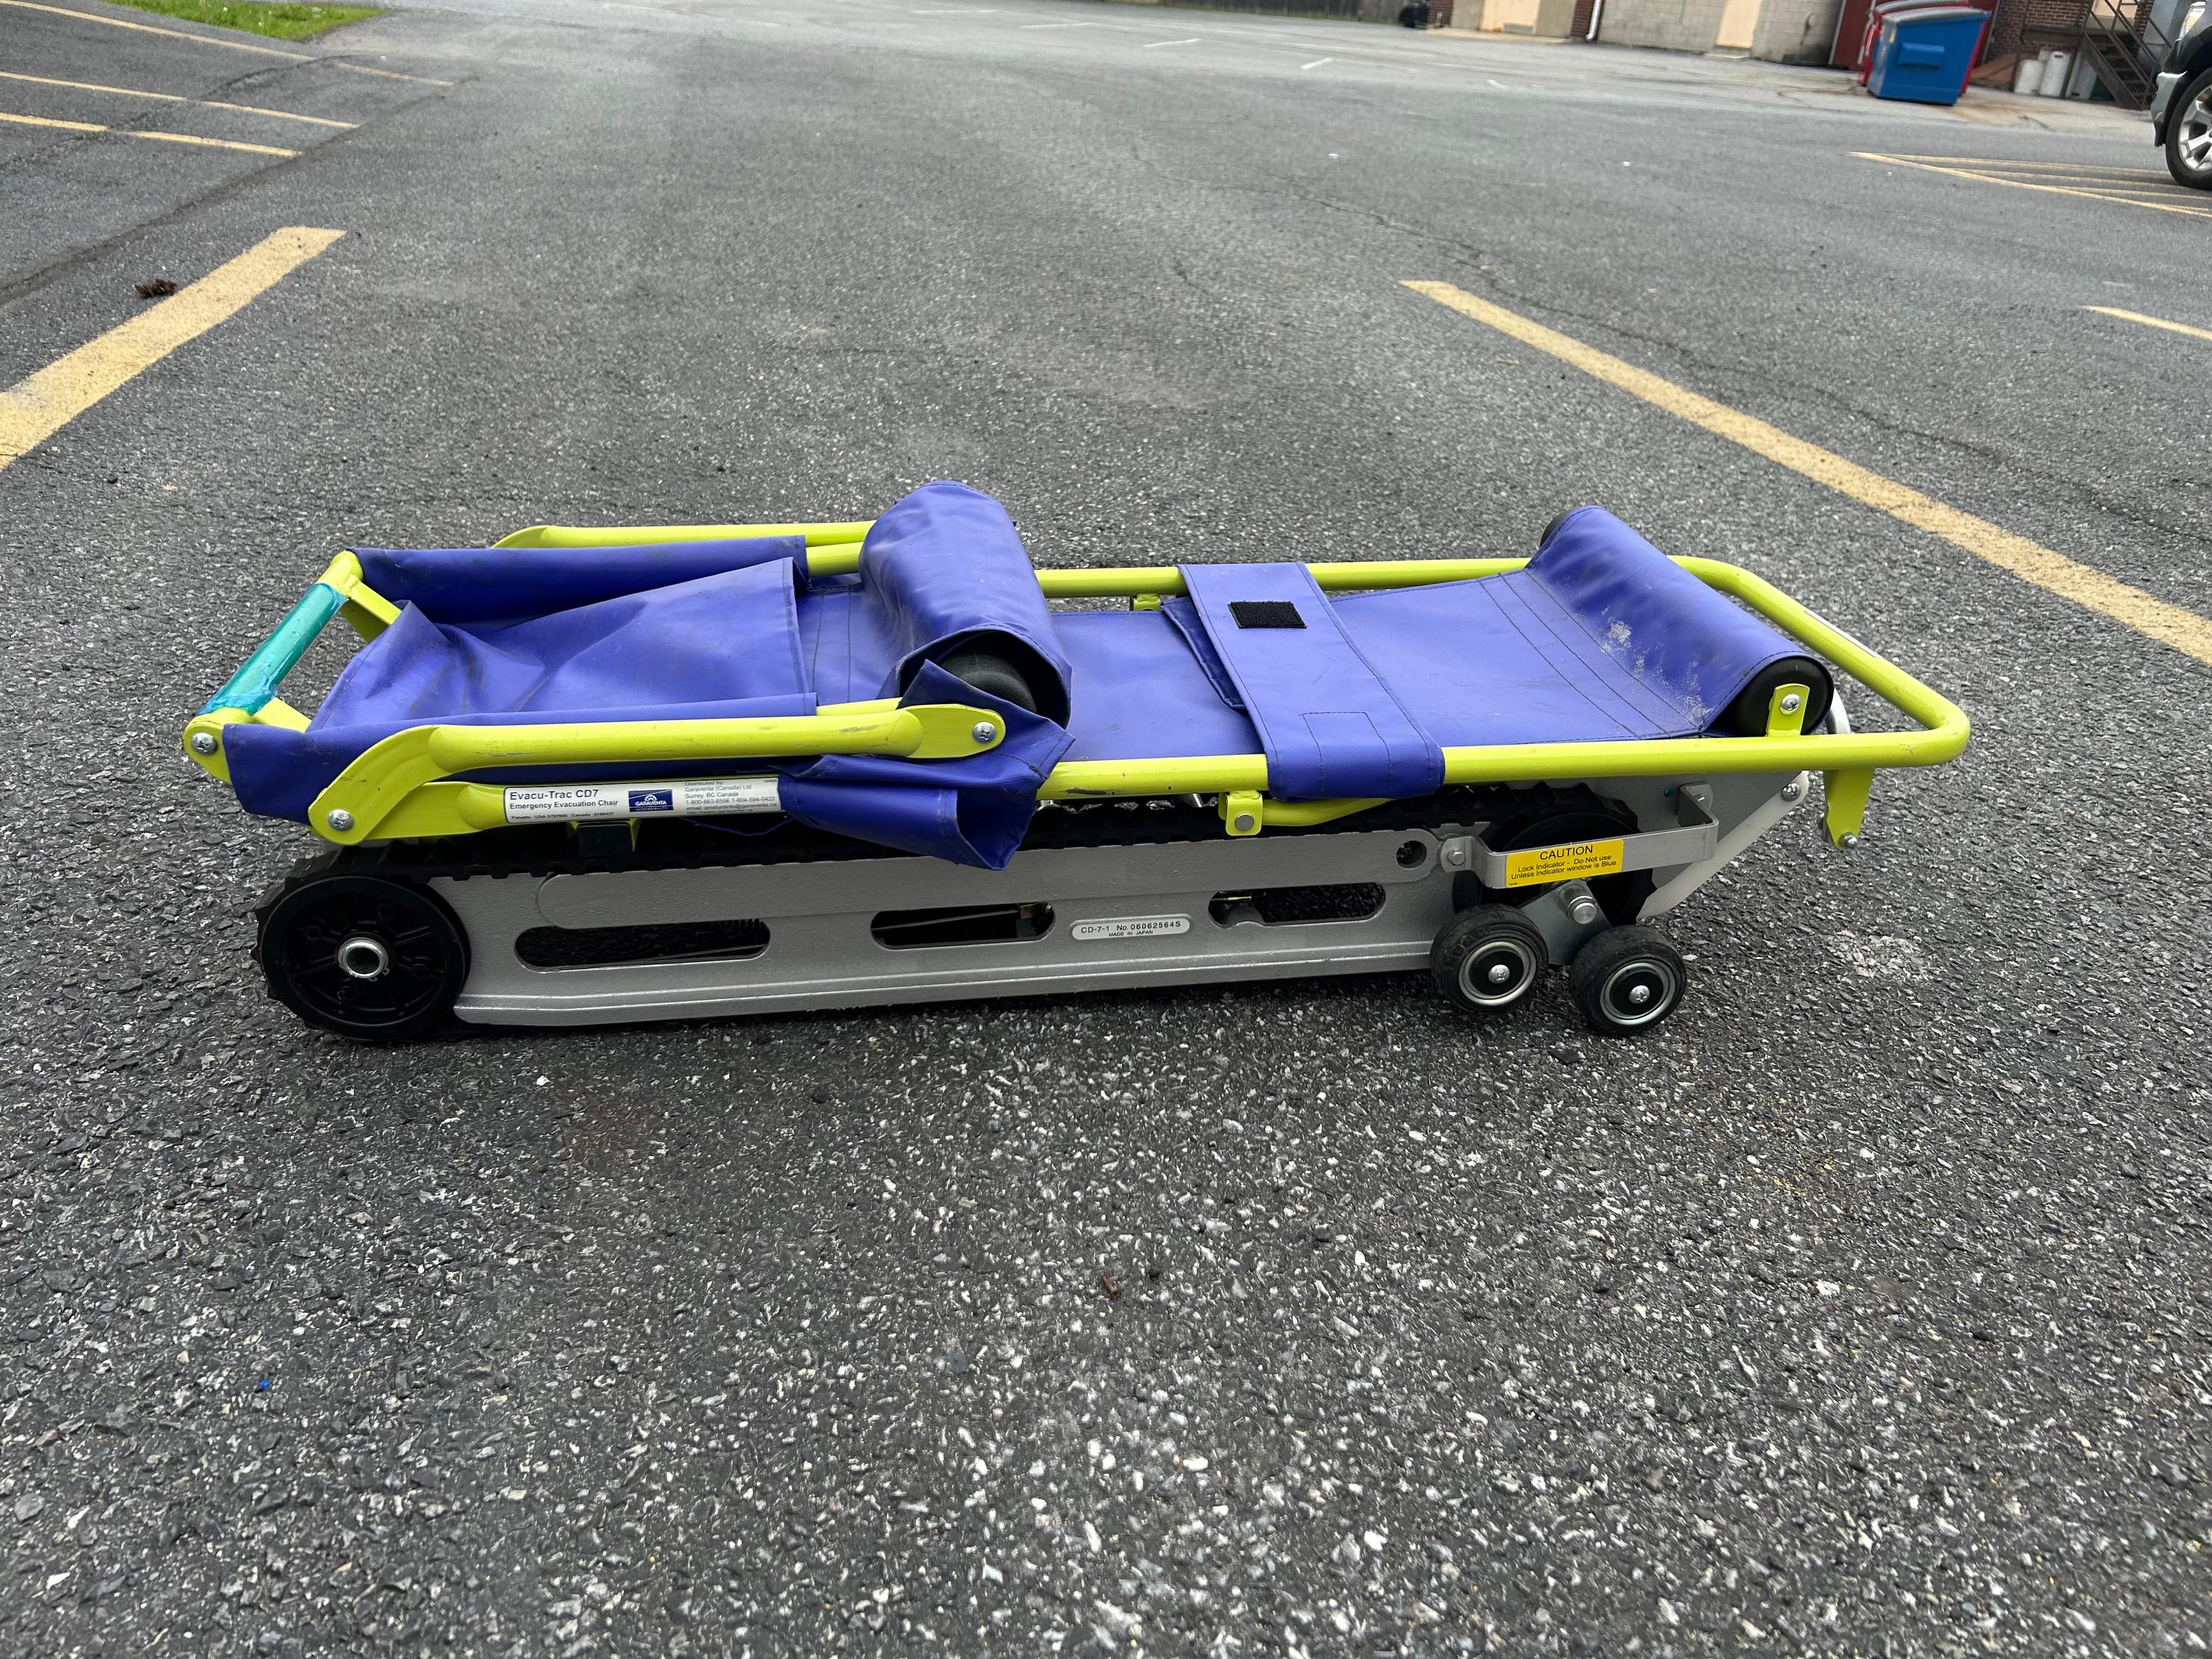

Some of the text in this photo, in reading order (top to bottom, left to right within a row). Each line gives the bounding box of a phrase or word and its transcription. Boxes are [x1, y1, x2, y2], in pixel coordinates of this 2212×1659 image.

[510, 789, 599, 800] Evacu-Trac CD7
[1540, 845, 1593, 860] CAUTION
[1536, 860, 1565, 870] Indicator
[1511, 872, 1534, 880] Unless
[1536, 867, 1565, 877] indicator
[1081, 925, 1110, 933] CD-7-1
